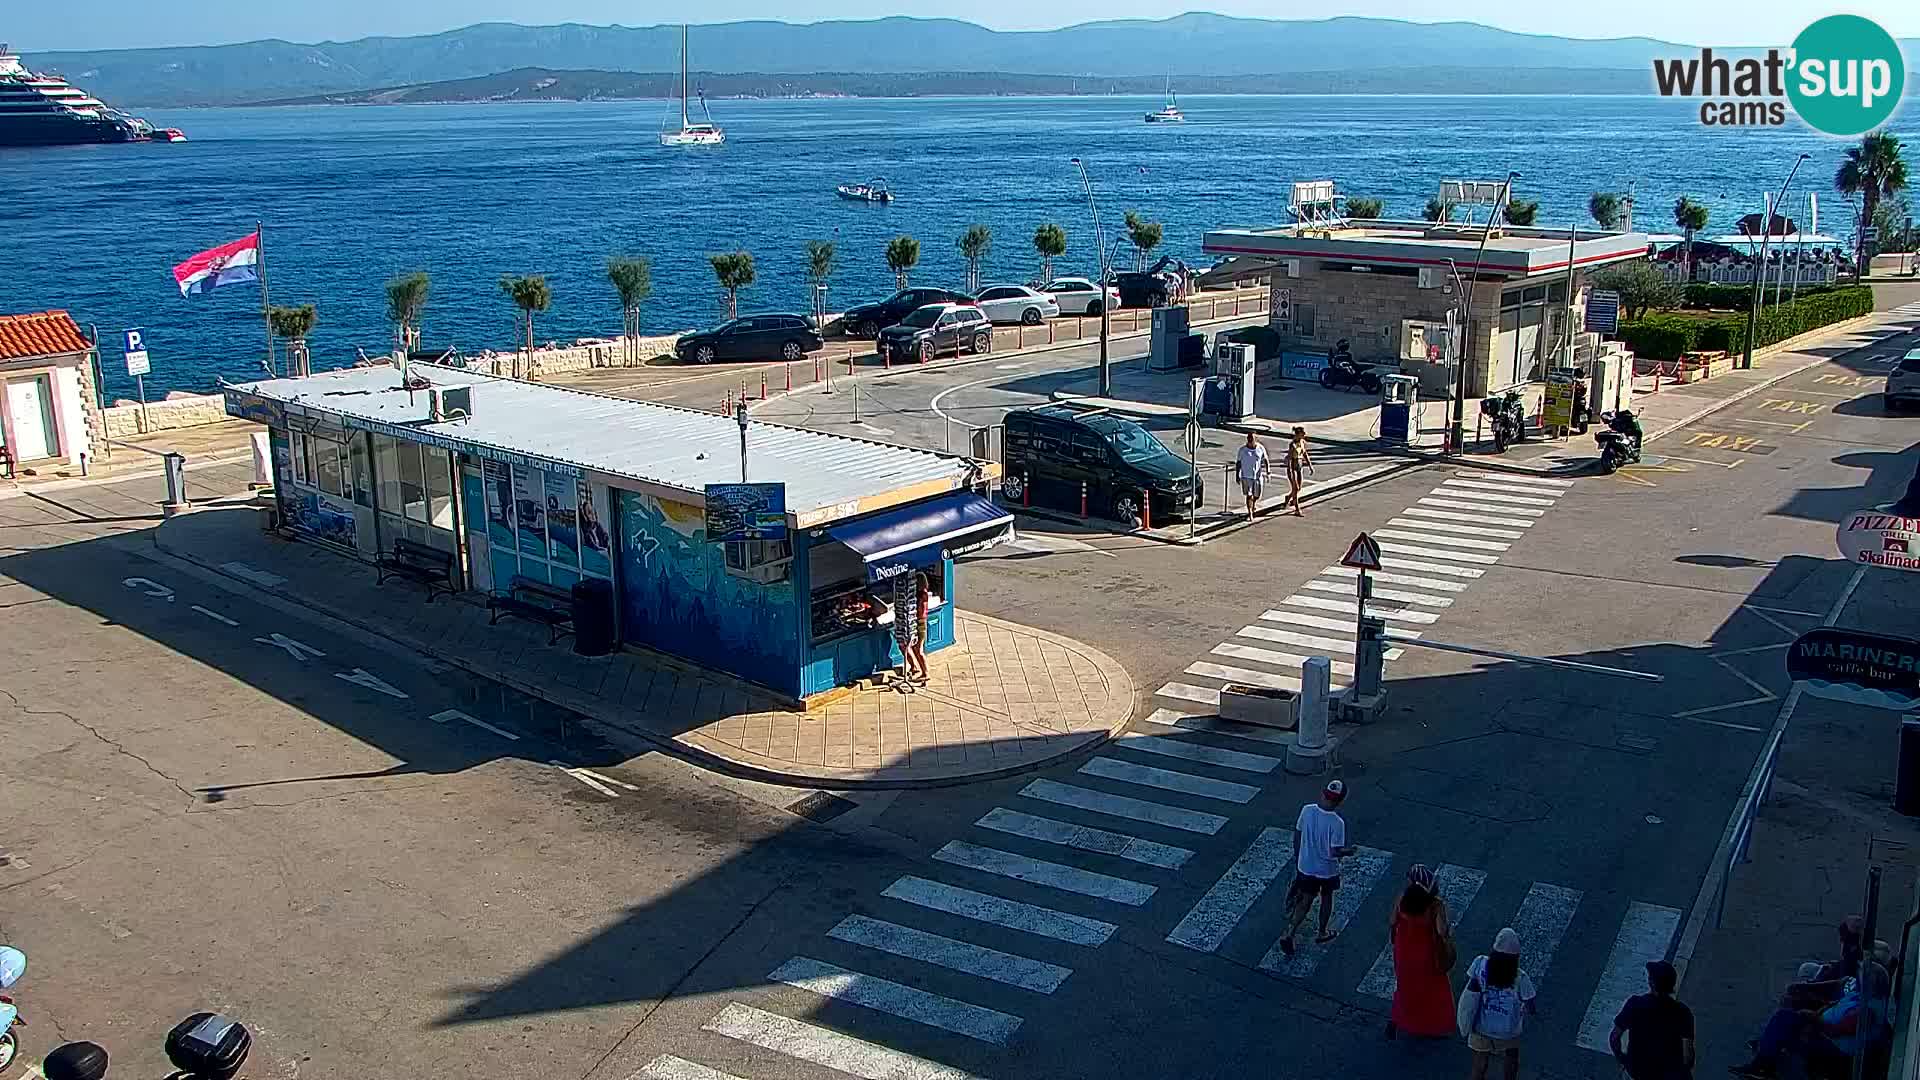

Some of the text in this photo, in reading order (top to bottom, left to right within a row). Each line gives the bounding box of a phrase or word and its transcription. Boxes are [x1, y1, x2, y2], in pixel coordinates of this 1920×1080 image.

[127, 331, 142, 350] P
[1812, 374, 1880, 388] TAXI
[1757, 398, 1828, 415] TAXI
[1684, 432, 1764, 452] TAXI
[492, 449, 525, 465] STATION
[527, 457, 553, 472] TICKET
[554, 463, 582, 477] OFFICE
[1881, 530, 1916, 541] GRILL
[1799, 642, 1920, 673] MARINER
[1869, 664, 1896, 681] bar
